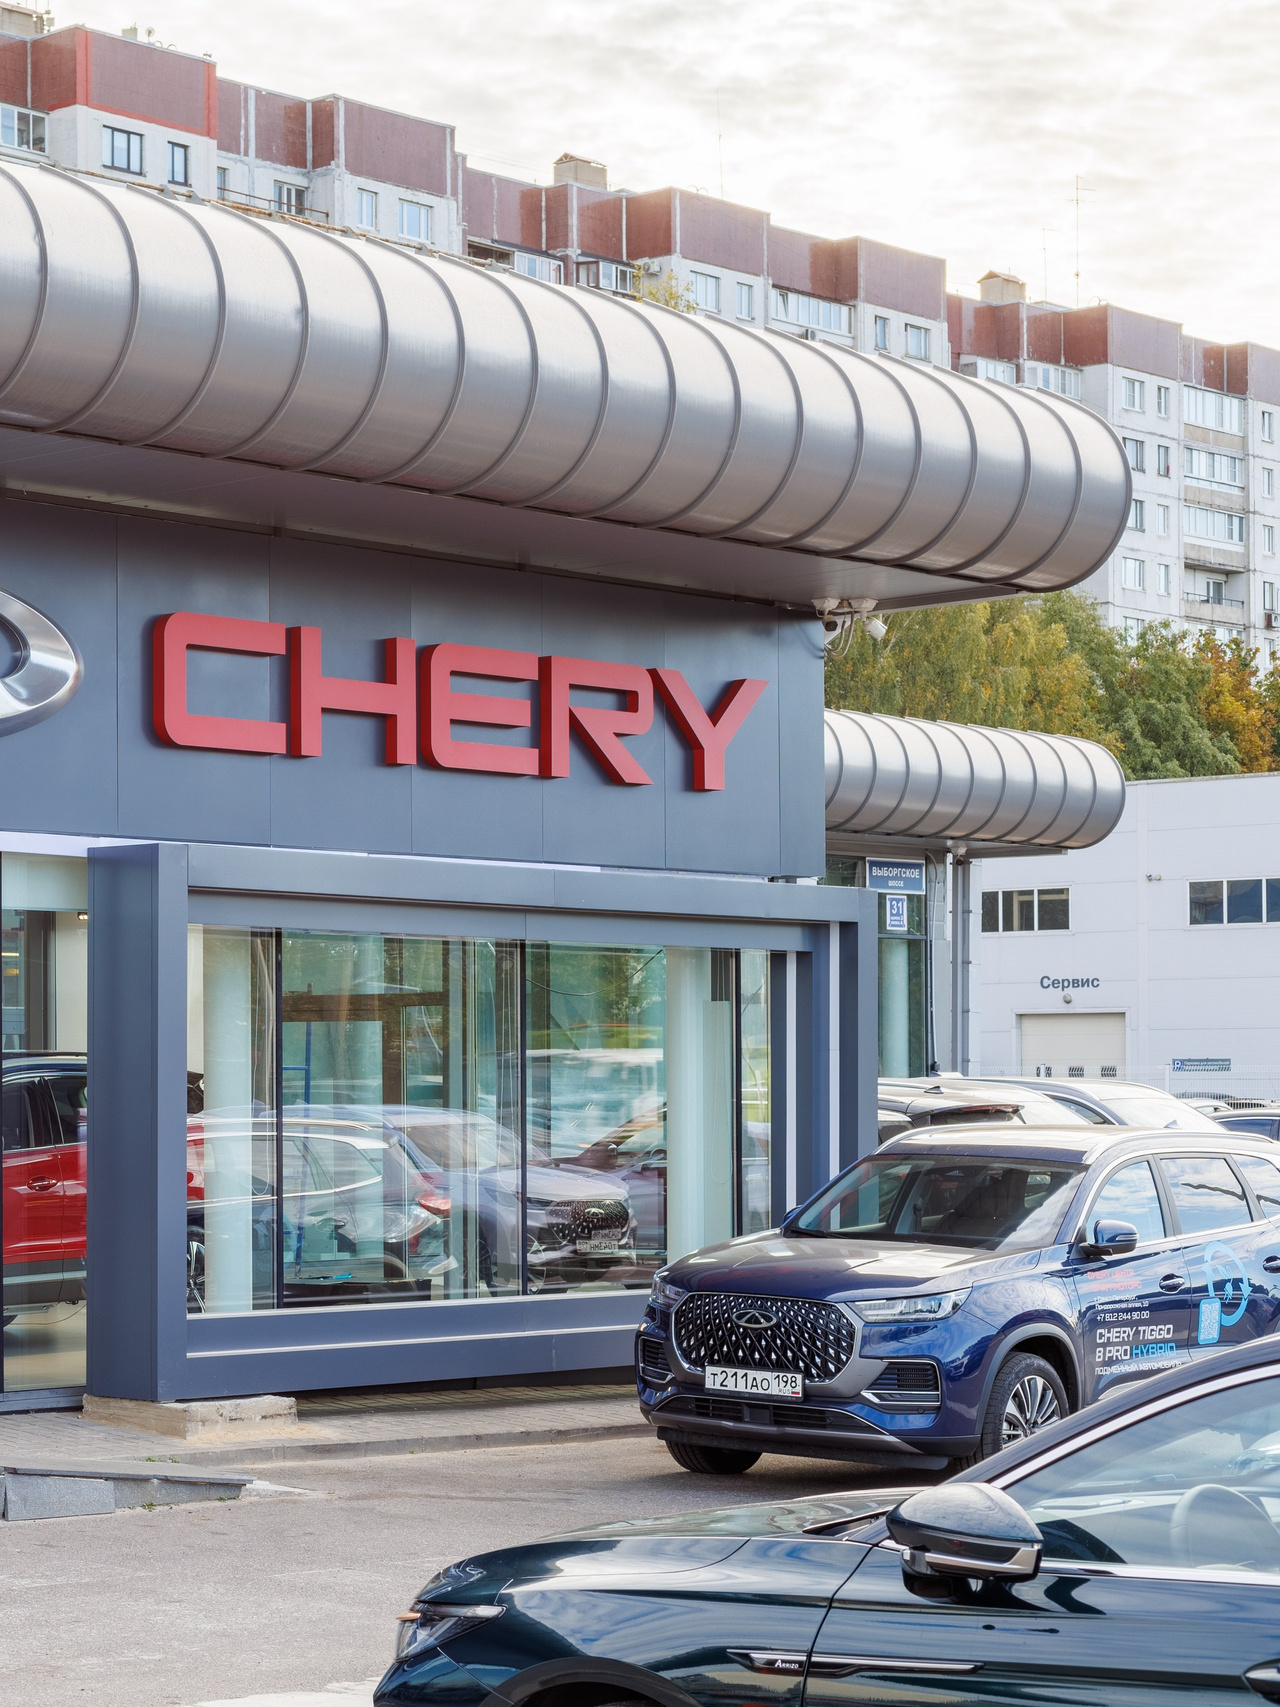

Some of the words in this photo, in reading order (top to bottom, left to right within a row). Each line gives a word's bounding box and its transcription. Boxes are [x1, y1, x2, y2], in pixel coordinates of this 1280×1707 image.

[153, 610, 770, 792] CHERY
[872, 866, 920, 879] ВЫБОРГСКОЕ
[891, 901, 902, 914] 31
[1040, 975, 1100, 992] Сервис
[1105, 1313, 1118, 1321] 812
[1119, 1312, 1131, 1320] 244
[1141, 1311, 1150, 1319] 00
[1096, 1327, 1136, 1343] CHERY
[1138, 1324, 1174, 1340] TIGGO
[1096, 1348, 1103, 1362] 8
[1106, 1346, 1130, 1361] PRO
[1132, 1342, 1177, 1359] HYBRID
[1095, 1363, 1139, 1376] ПОДМЕННЫЙ
[711, 1370, 770, 1391] Т211АО
[774, 1374, 797, 1389] 198
